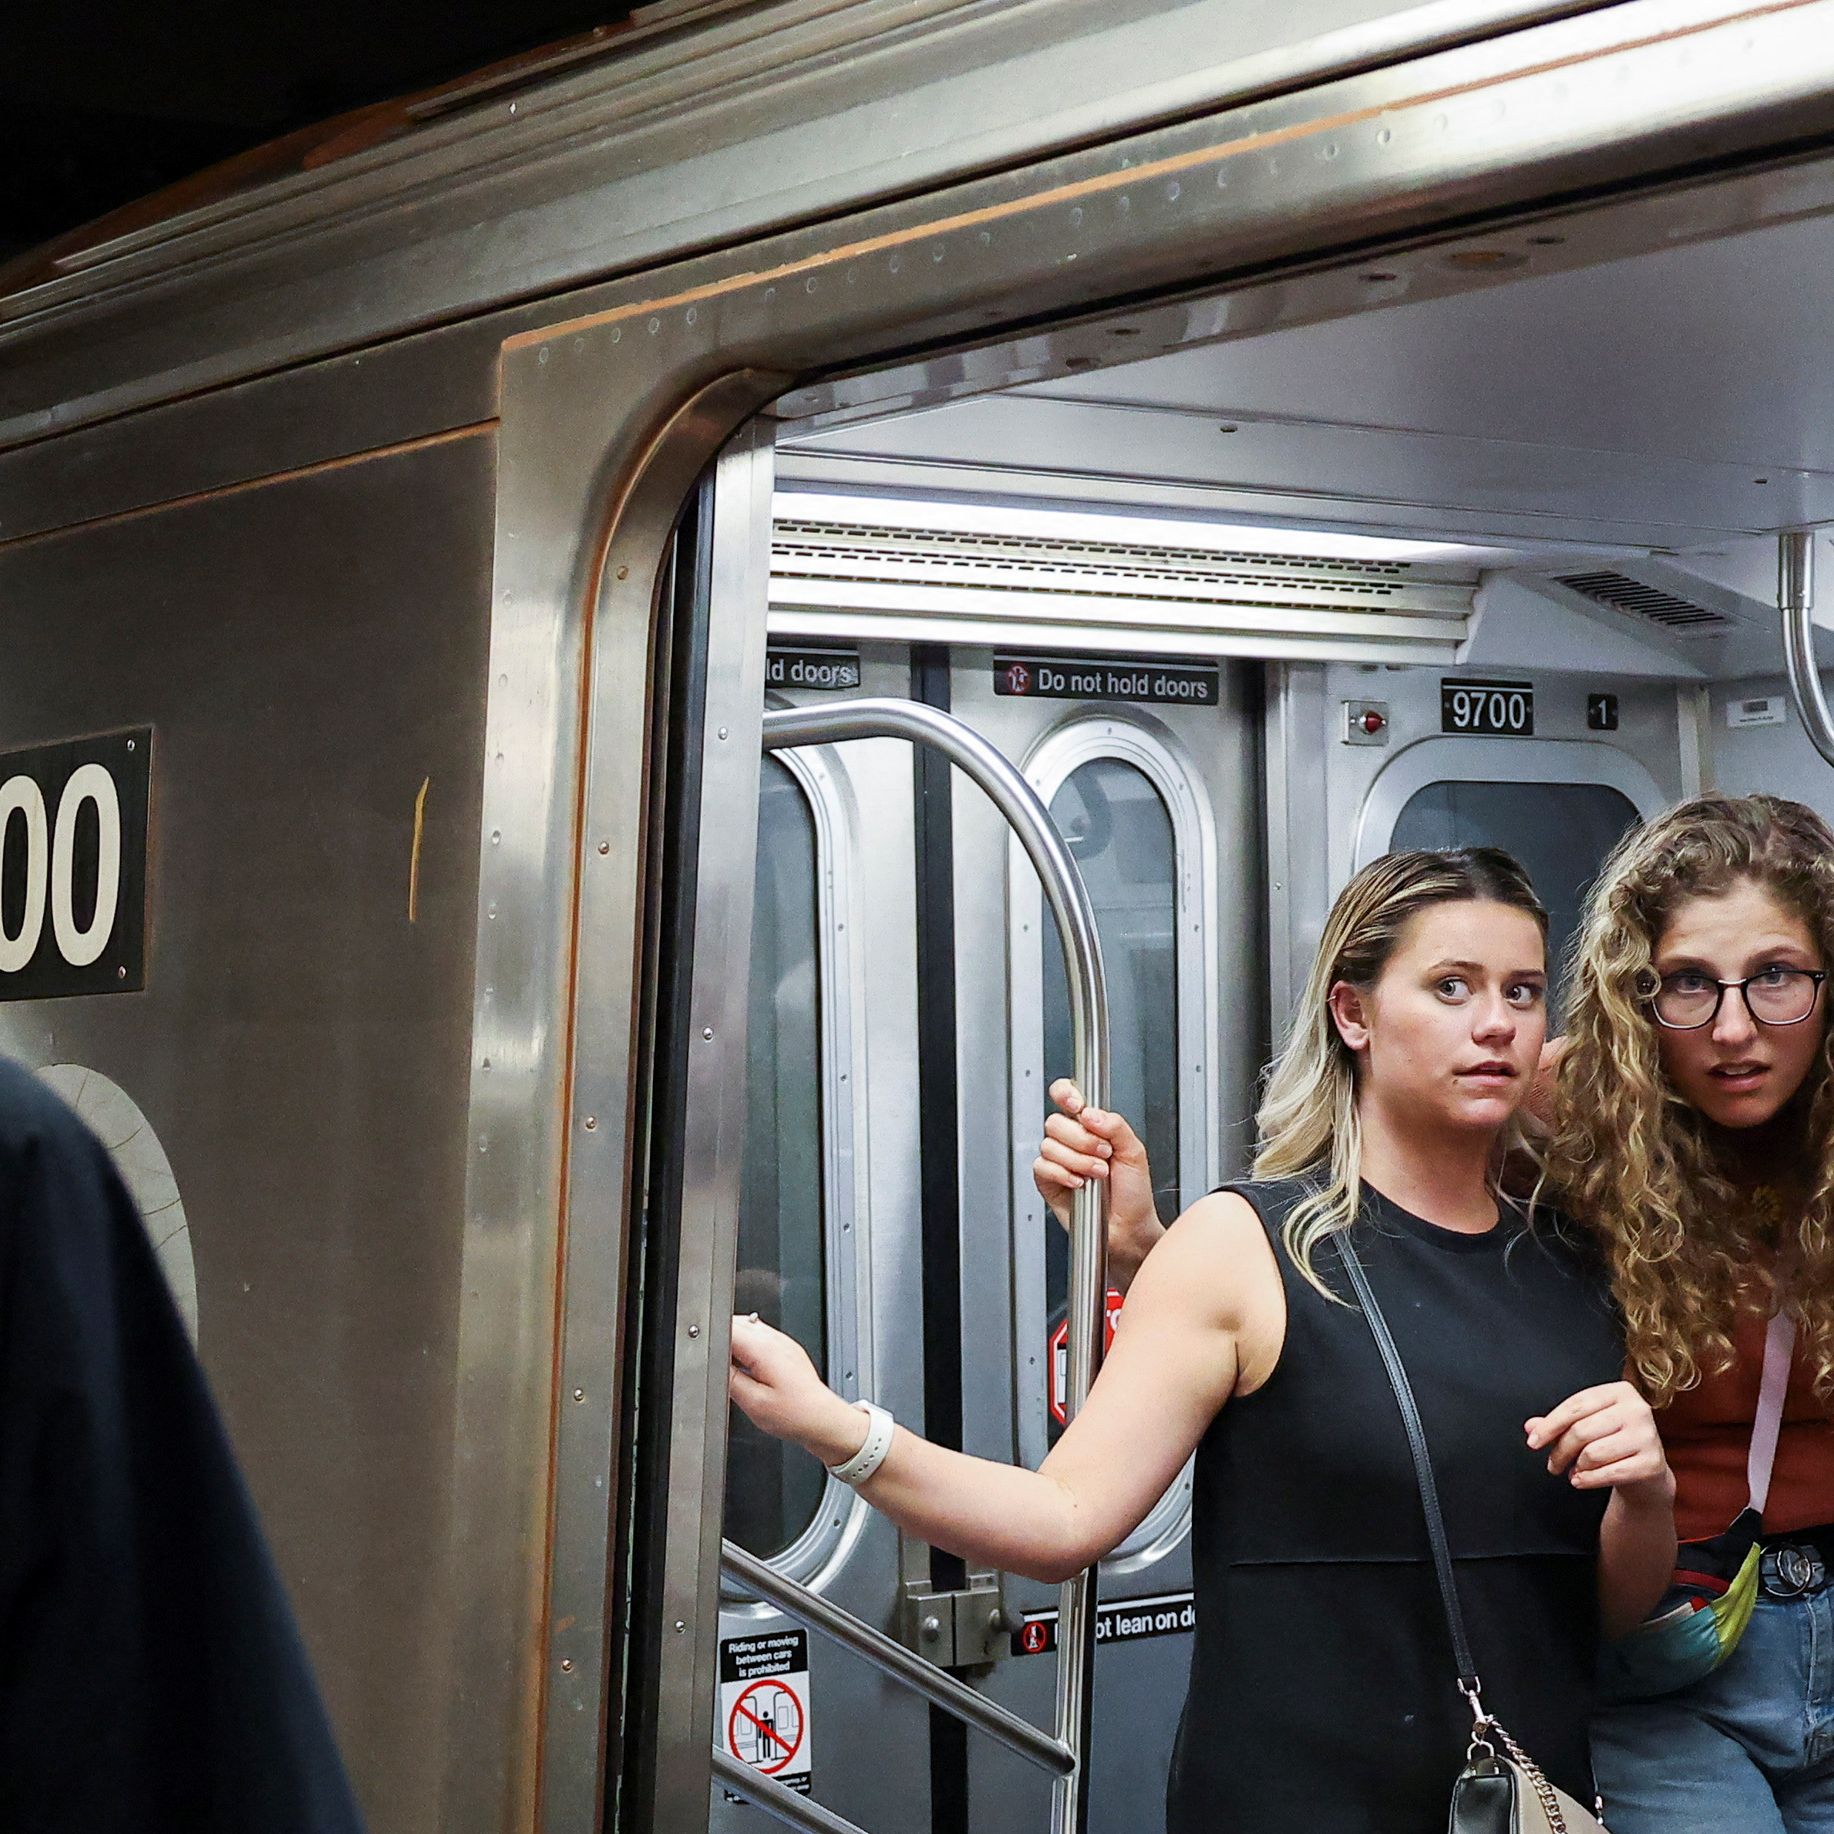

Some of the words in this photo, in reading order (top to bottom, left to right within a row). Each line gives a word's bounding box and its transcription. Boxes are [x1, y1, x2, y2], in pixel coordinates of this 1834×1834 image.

[766, 658, 784, 681] ld
[790, 660, 851, 684] doors
[1038, 668, 1065, 691] Do
[1071, 672, 1102, 693] not
[1107, 672, 1149, 695] hold
[1154, 675, 1208, 698] doors
[1453, 691, 1526, 729] 9700
[1598, 699, 1607, 725] 1
[1096, 1621, 1112, 1639] ot
[1116, 1614, 1153, 1636] lean
[1154, 1611, 1177, 1631] on
[728, 1642, 756, 1653] Riding
[757, 1641, 767, 1649] or
[767, 1636, 799, 1648] moving
[735, 1652, 772, 1665] between
[773, 1649, 793, 1660] cars
[738, 1667, 747, 1677] is
[747, 1661, 791, 1678] prohibited
